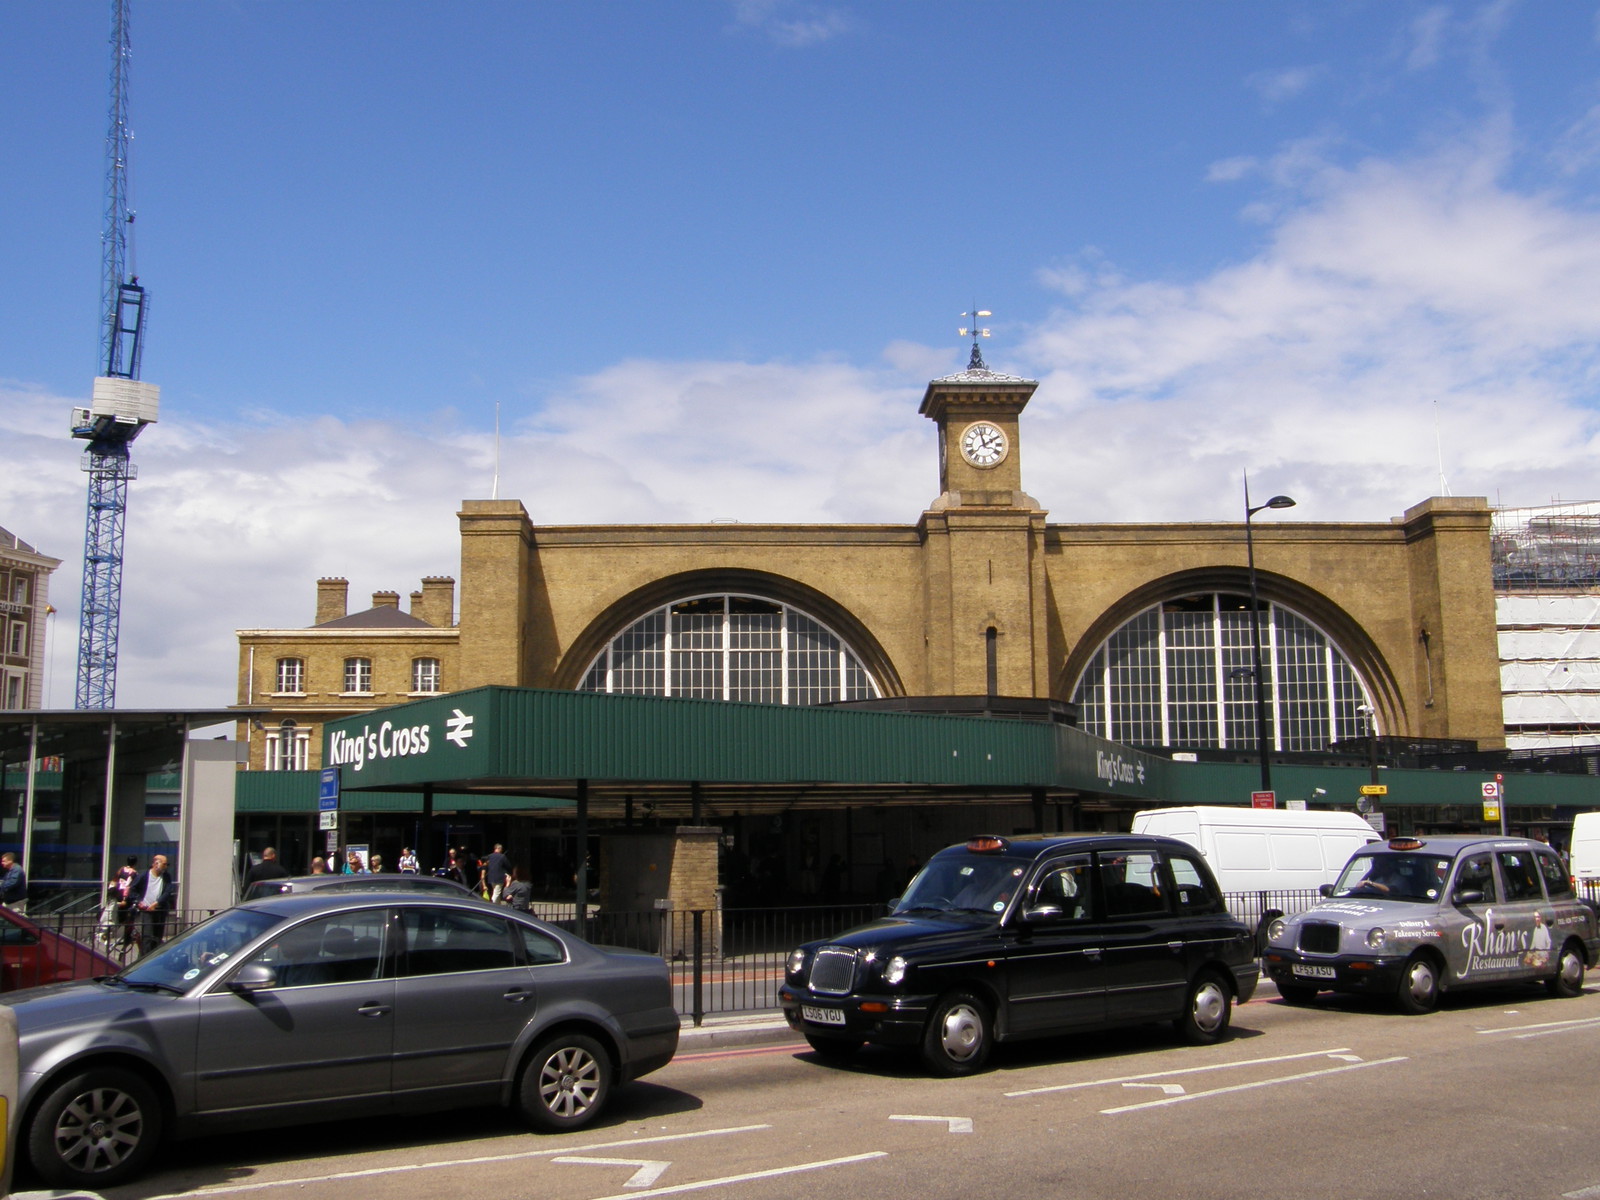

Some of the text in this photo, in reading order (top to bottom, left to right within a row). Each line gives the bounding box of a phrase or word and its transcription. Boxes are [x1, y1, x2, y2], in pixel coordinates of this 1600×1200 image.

[959, 328, 967, 336] W
[330, 721, 430, 771] King's Cross
[1096, 750, 1117, 787] King's
[1393, 930, 1421, 939] Takeaway
[1457, 908, 1528, 979] Khan's
[1471, 955, 1520, 970] Restaurant
